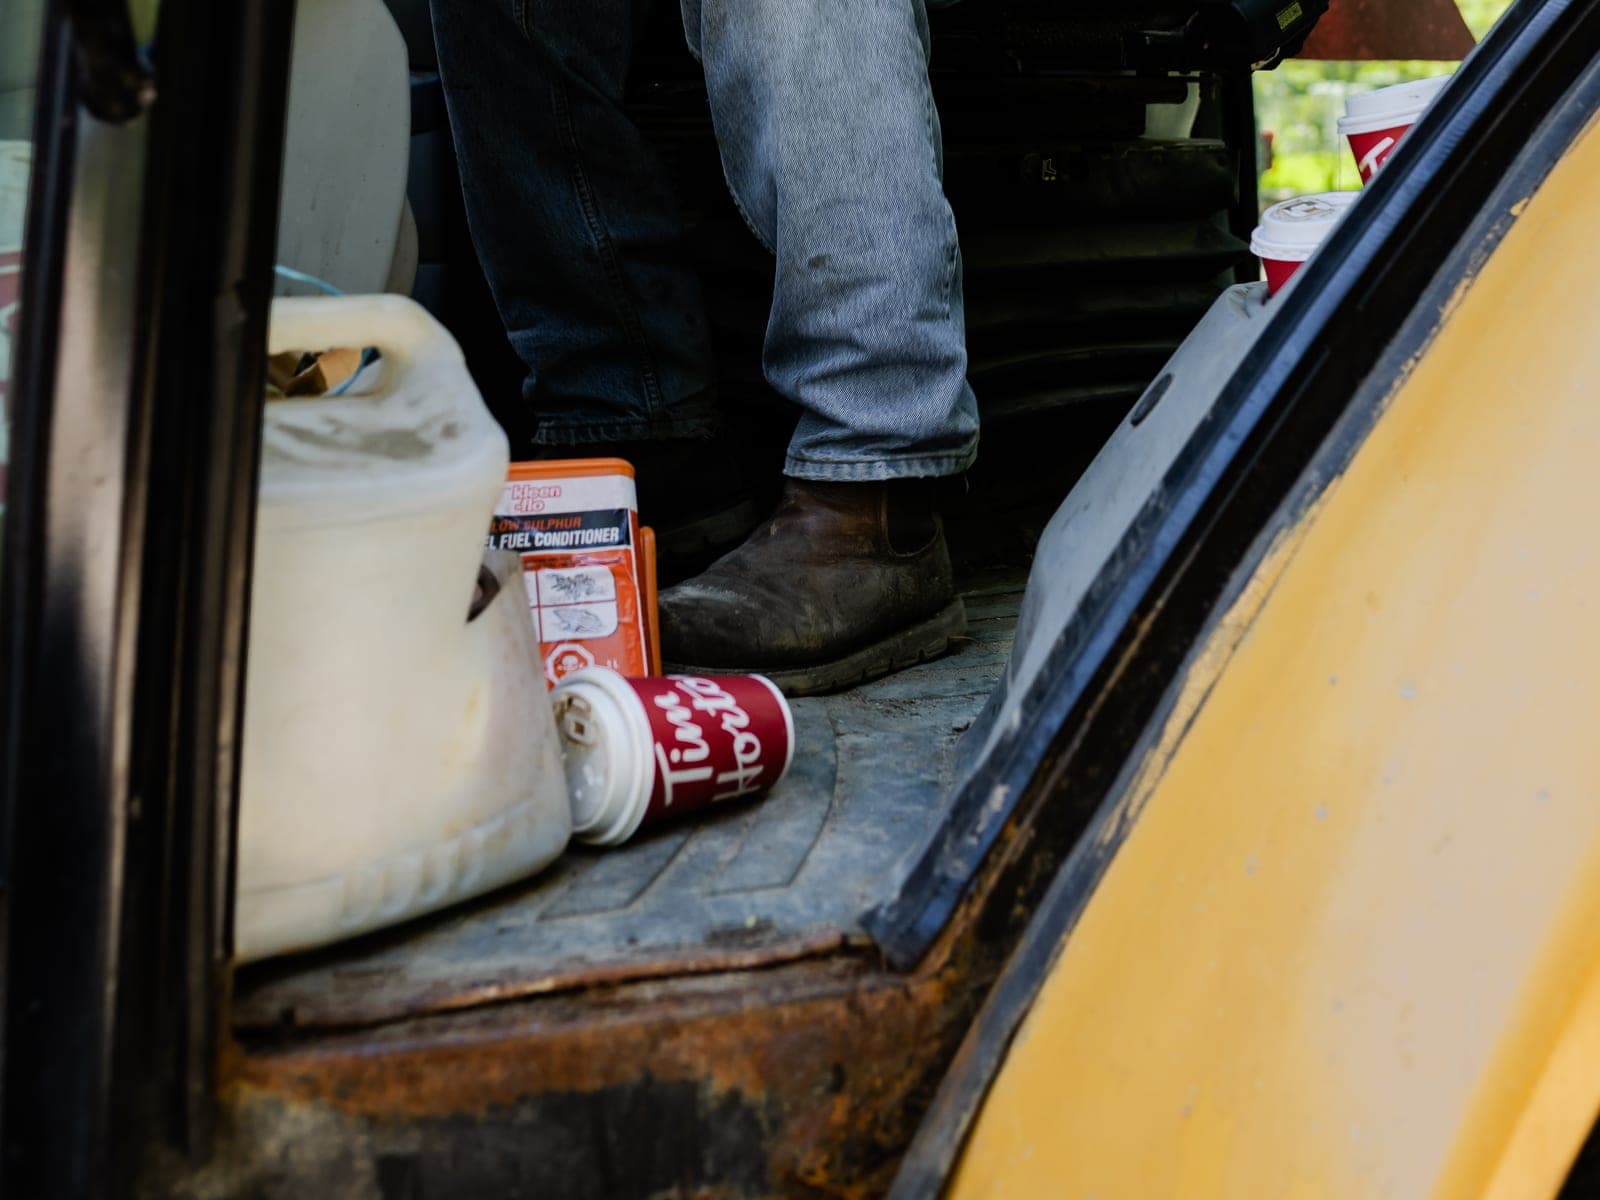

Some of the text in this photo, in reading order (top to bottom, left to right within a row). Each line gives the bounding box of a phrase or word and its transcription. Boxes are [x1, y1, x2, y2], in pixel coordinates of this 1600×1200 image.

[511, 484, 562, 500] kleen
[492, 516, 582, 534] LOW SULPHUR
[499, 531, 532, 550] FUEL
[534, 526, 620, 547] CONDITIONER
[653, 690, 714, 807] Tim
[667, 674, 765, 803] Horto
